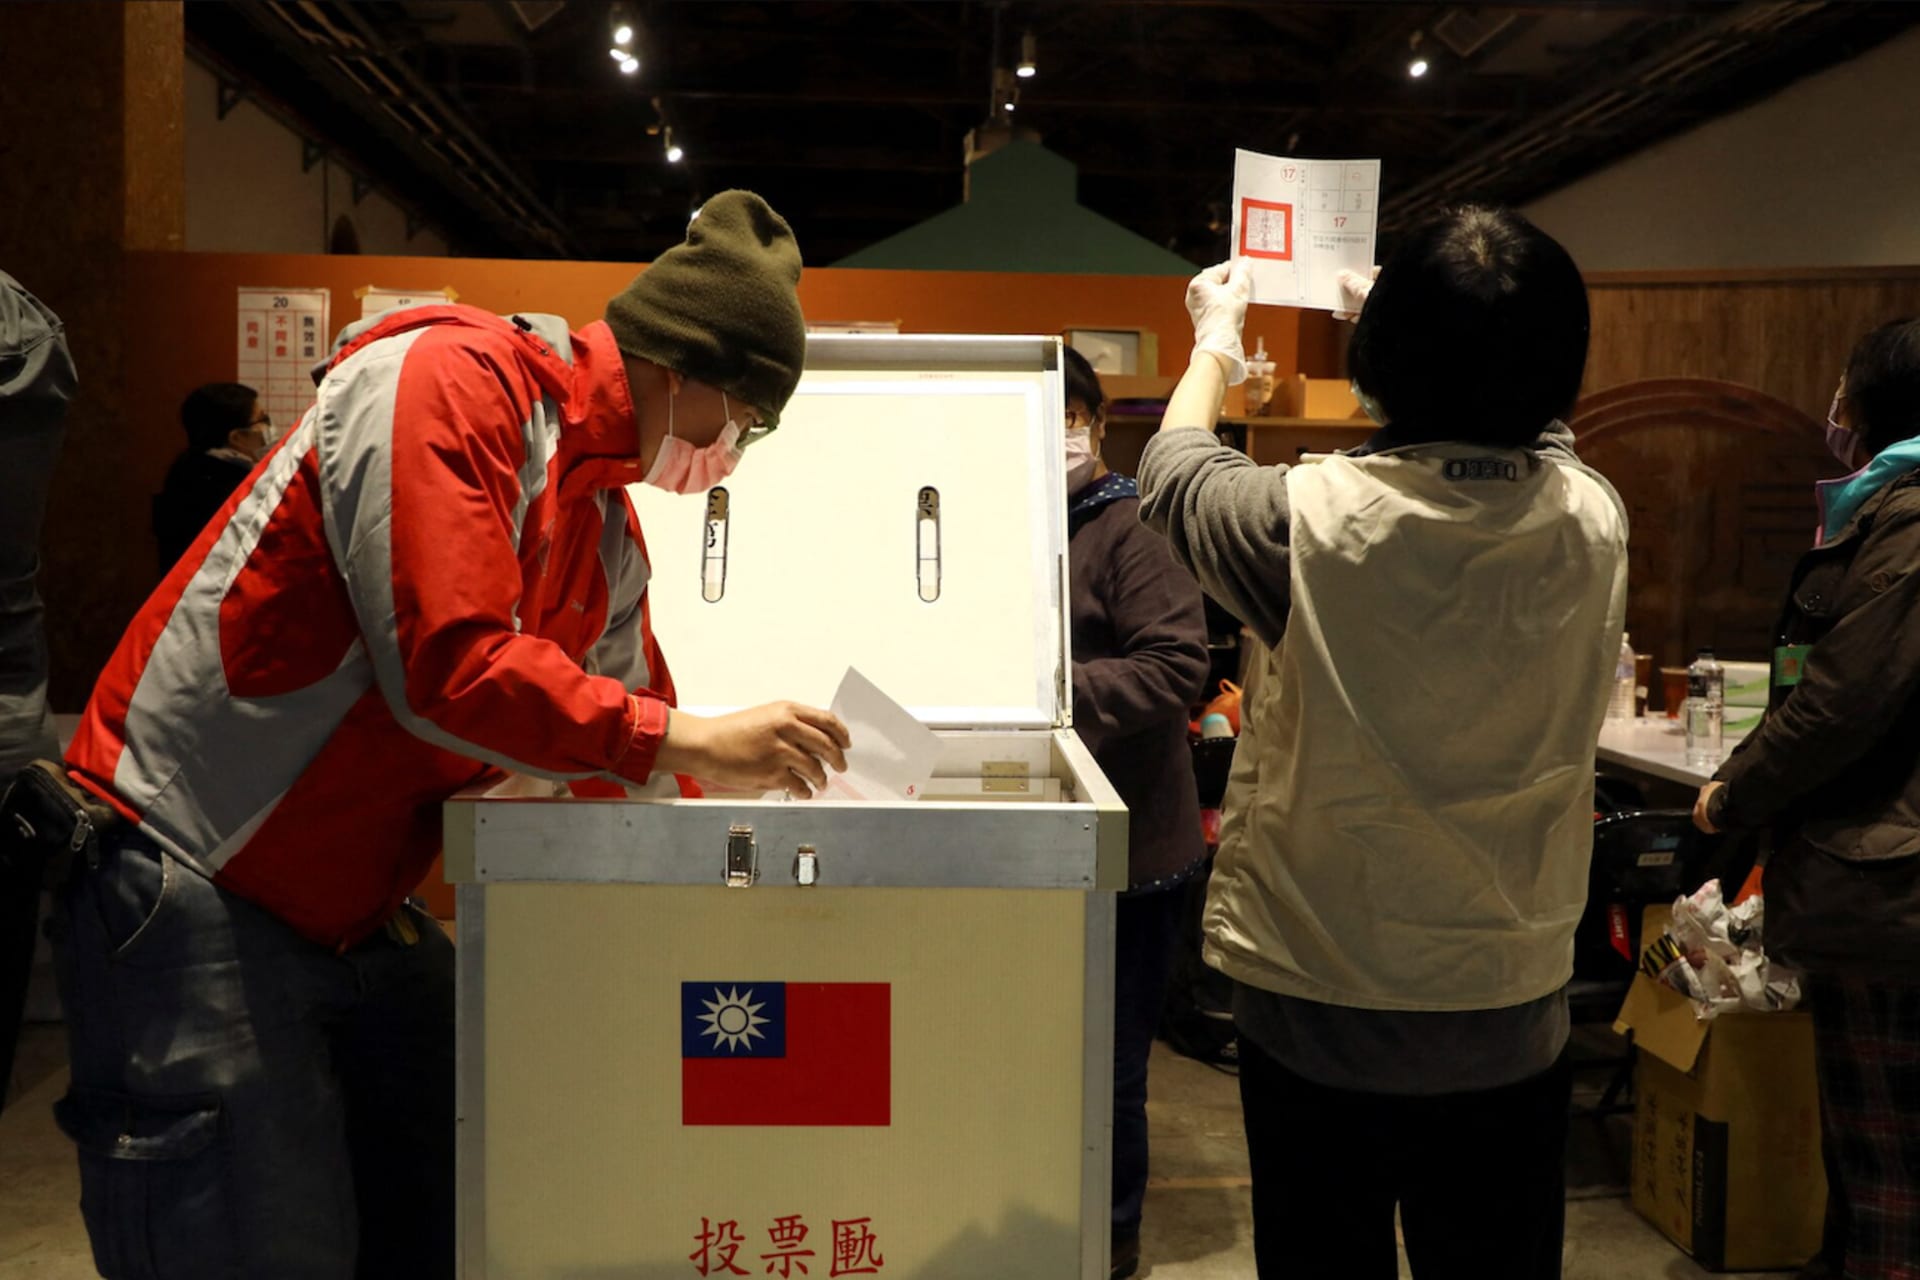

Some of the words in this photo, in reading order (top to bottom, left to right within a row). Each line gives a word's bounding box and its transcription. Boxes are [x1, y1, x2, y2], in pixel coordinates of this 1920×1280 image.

[1333, 216, 1347, 228] 17
[272, 296, 289, 309] 20
[689, 1214, 884, 1279] 投票匭
